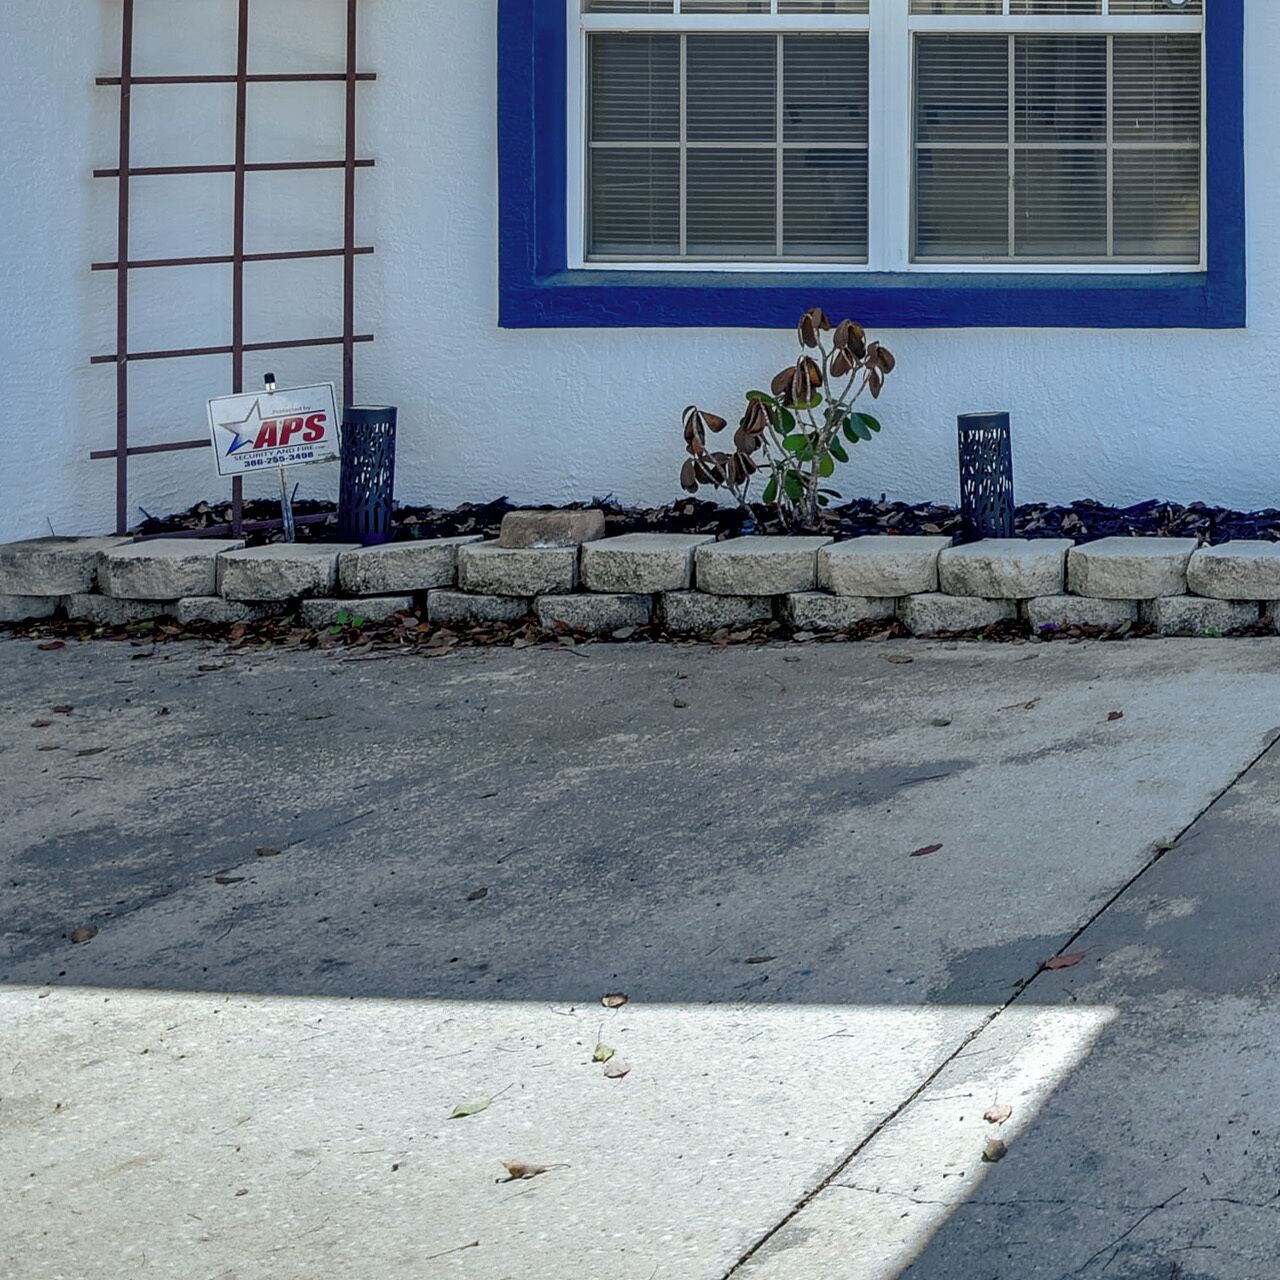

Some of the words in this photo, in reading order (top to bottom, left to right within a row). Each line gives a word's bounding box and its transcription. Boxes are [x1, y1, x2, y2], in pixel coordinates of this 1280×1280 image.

[253, 413, 327, 450] APS
[233, 450, 274, 461] SECURITY
[276, 446, 295, 456] AND
